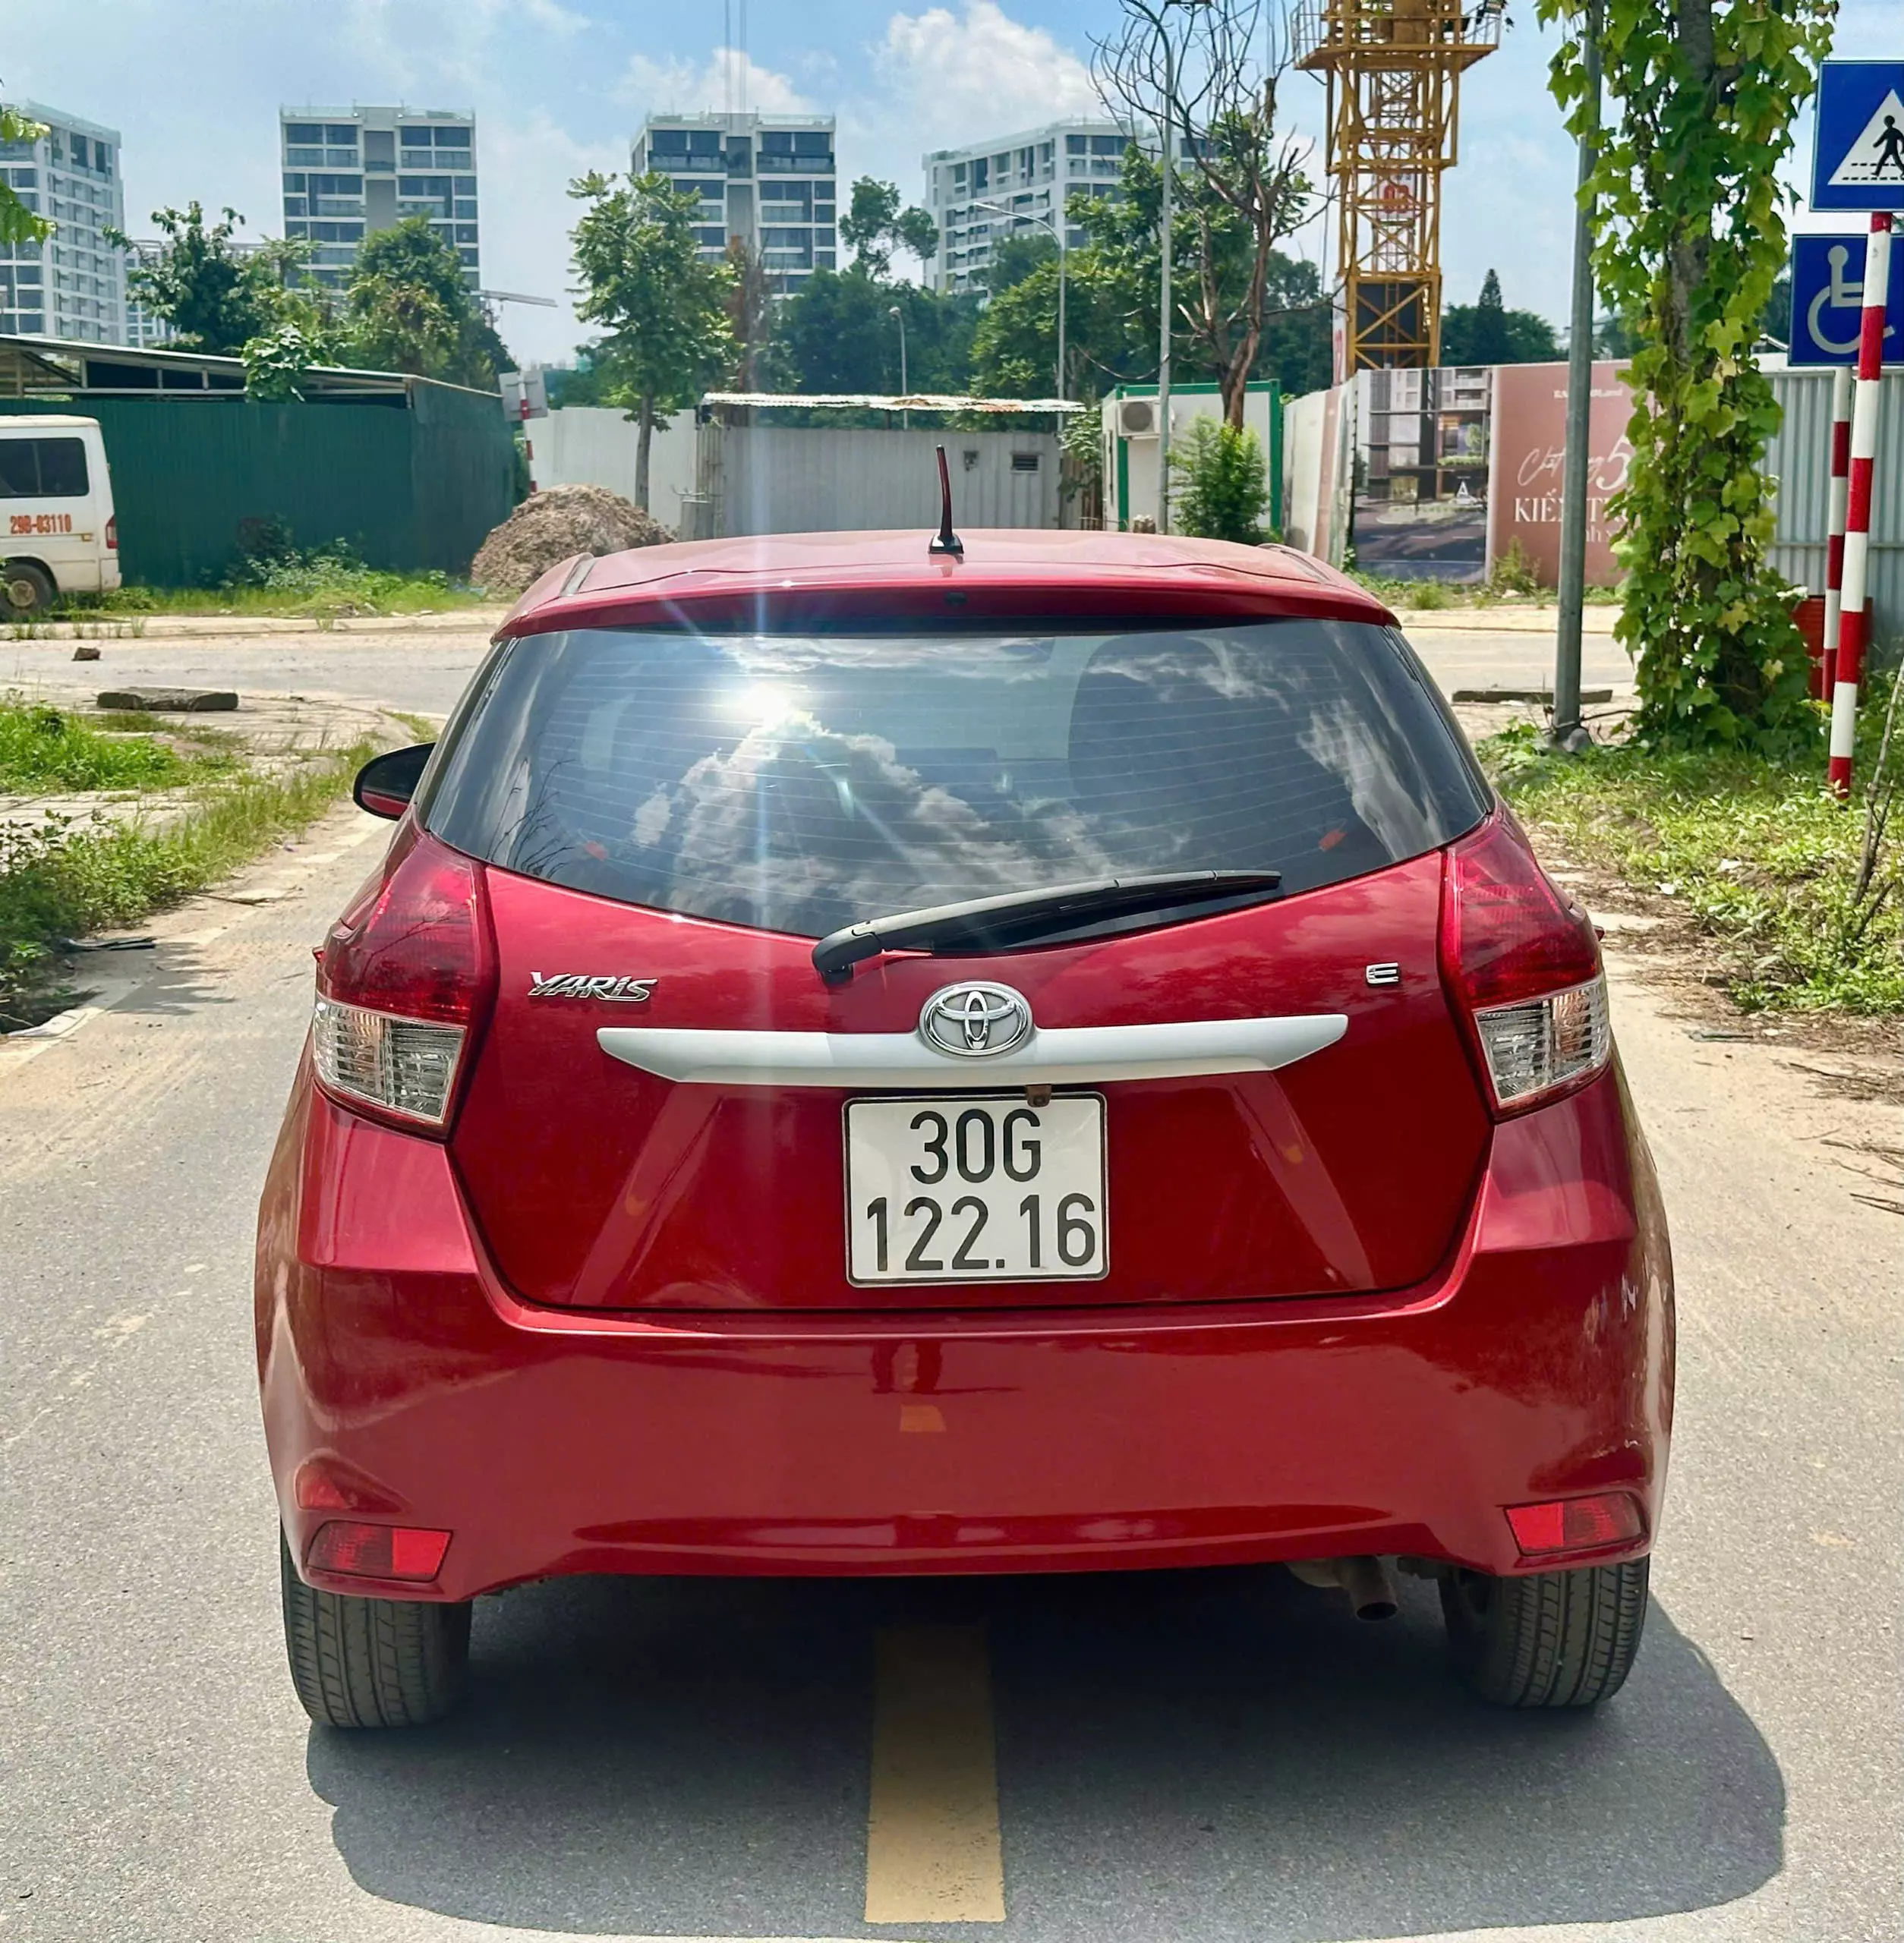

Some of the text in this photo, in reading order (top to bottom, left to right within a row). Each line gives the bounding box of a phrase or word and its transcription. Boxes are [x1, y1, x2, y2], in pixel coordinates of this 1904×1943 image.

[1515, 488, 1564, 522] KIẾ
[528, 972, 657, 1002] YARIS
[1367, 962, 1399, 984] E
[910, 1109, 1041, 1184] 30G
[867, 1193, 1095, 1271] 122.16
